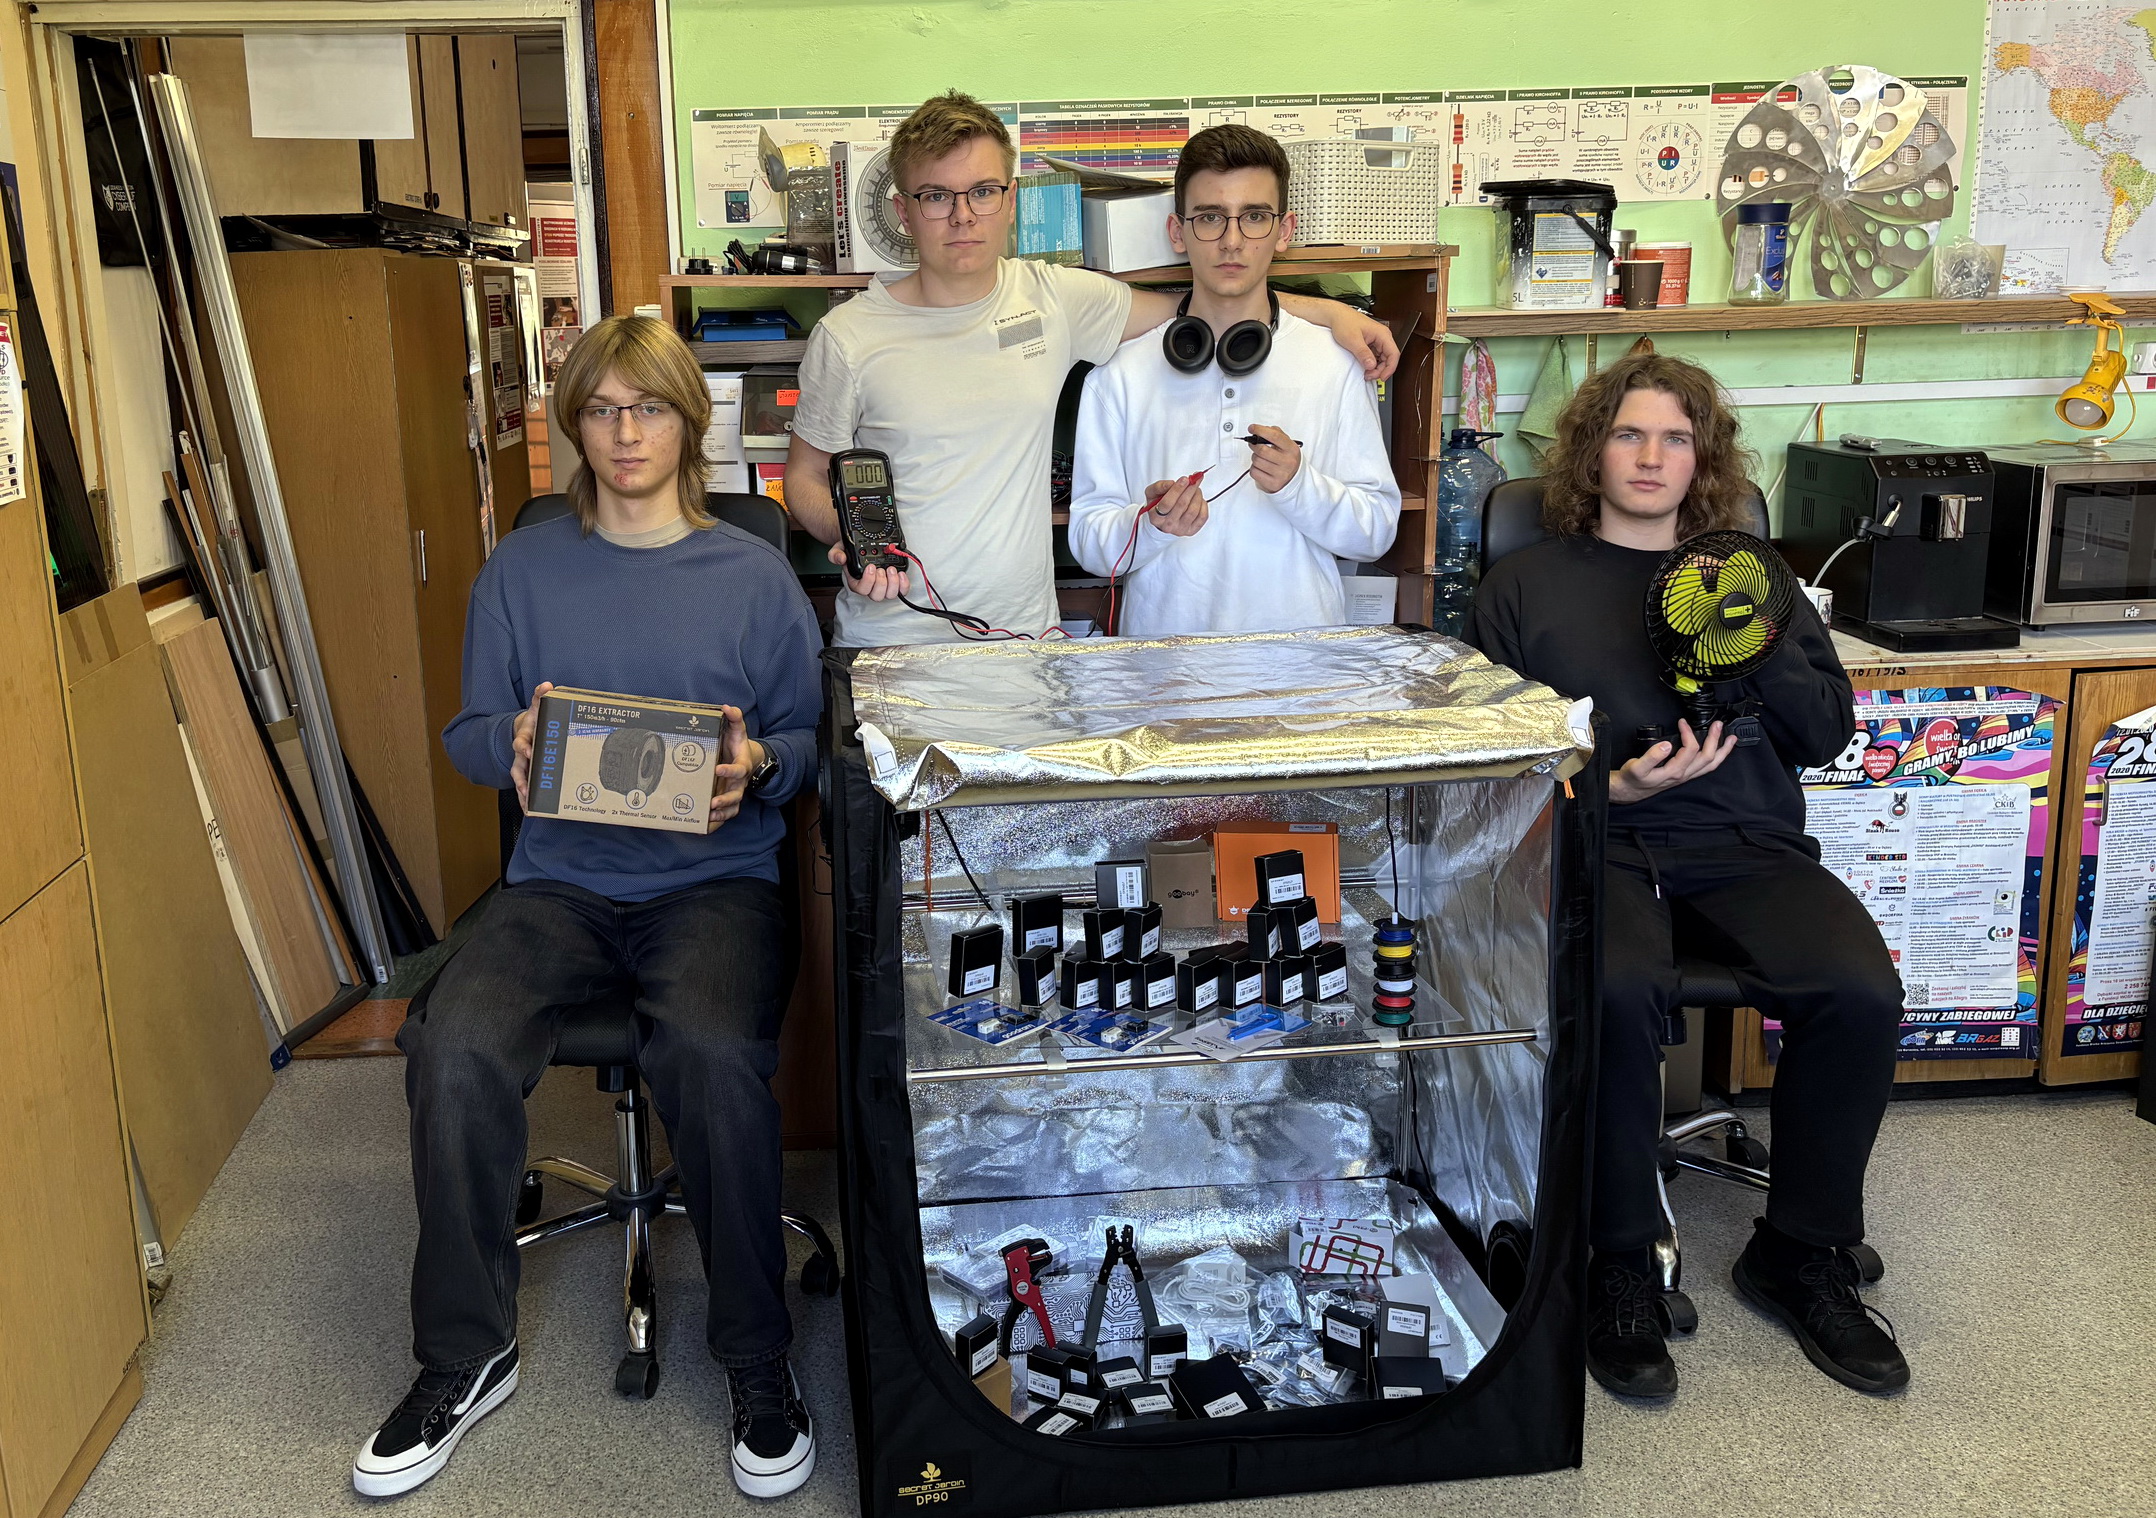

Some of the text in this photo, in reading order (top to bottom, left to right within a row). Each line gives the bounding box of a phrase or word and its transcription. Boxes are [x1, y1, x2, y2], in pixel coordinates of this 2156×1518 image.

[834, 161, 843, 216] create
[1513, 293, 1524, 302] 5L
[578, 704, 640, 718] DF16 EXTRACTOR
[540, 720, 560, 789] DF16E150
[1903, 724, 2035, 776] GRAMY, BO LUBIMY
[1824, 770, 1866, 782] FINAŁ
[579, 806, 606, 814] Technology
[1940, 1010, 2016, 1020] ZABIEGOWEJ
[2083, 1007, 2104, 1019] DLA
[898, 1484, 933, 1493] secret
[916, 1491, 948, 1506] DP90
